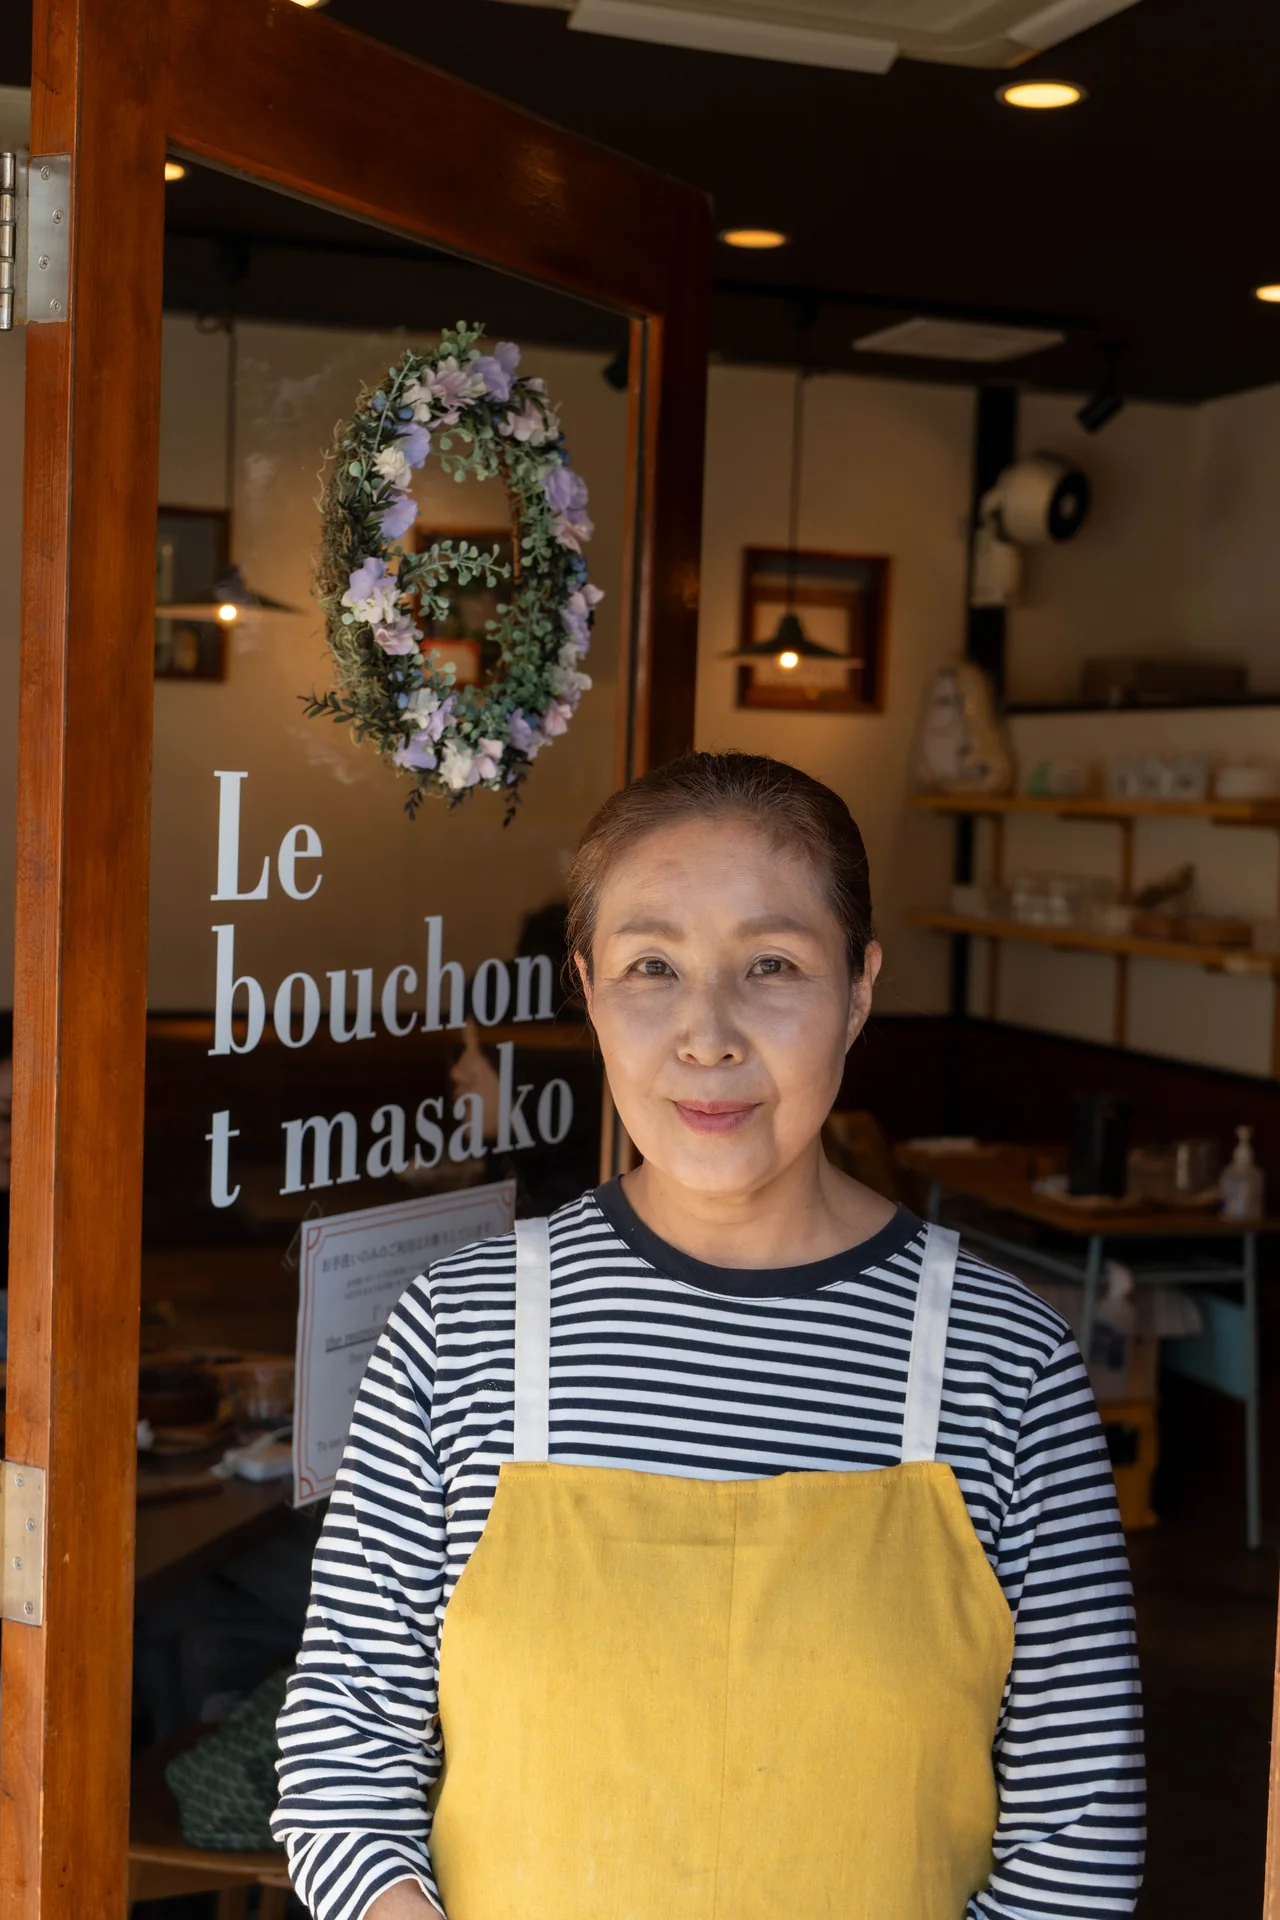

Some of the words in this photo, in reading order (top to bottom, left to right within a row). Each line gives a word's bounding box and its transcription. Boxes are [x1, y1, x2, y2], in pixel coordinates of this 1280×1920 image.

[211, 770, 323, 901] Le
[208, 915, 555, 1056] bouchon
[205, 1110, 241, 1209] t
[279, 1041, 574, 1195] masako
